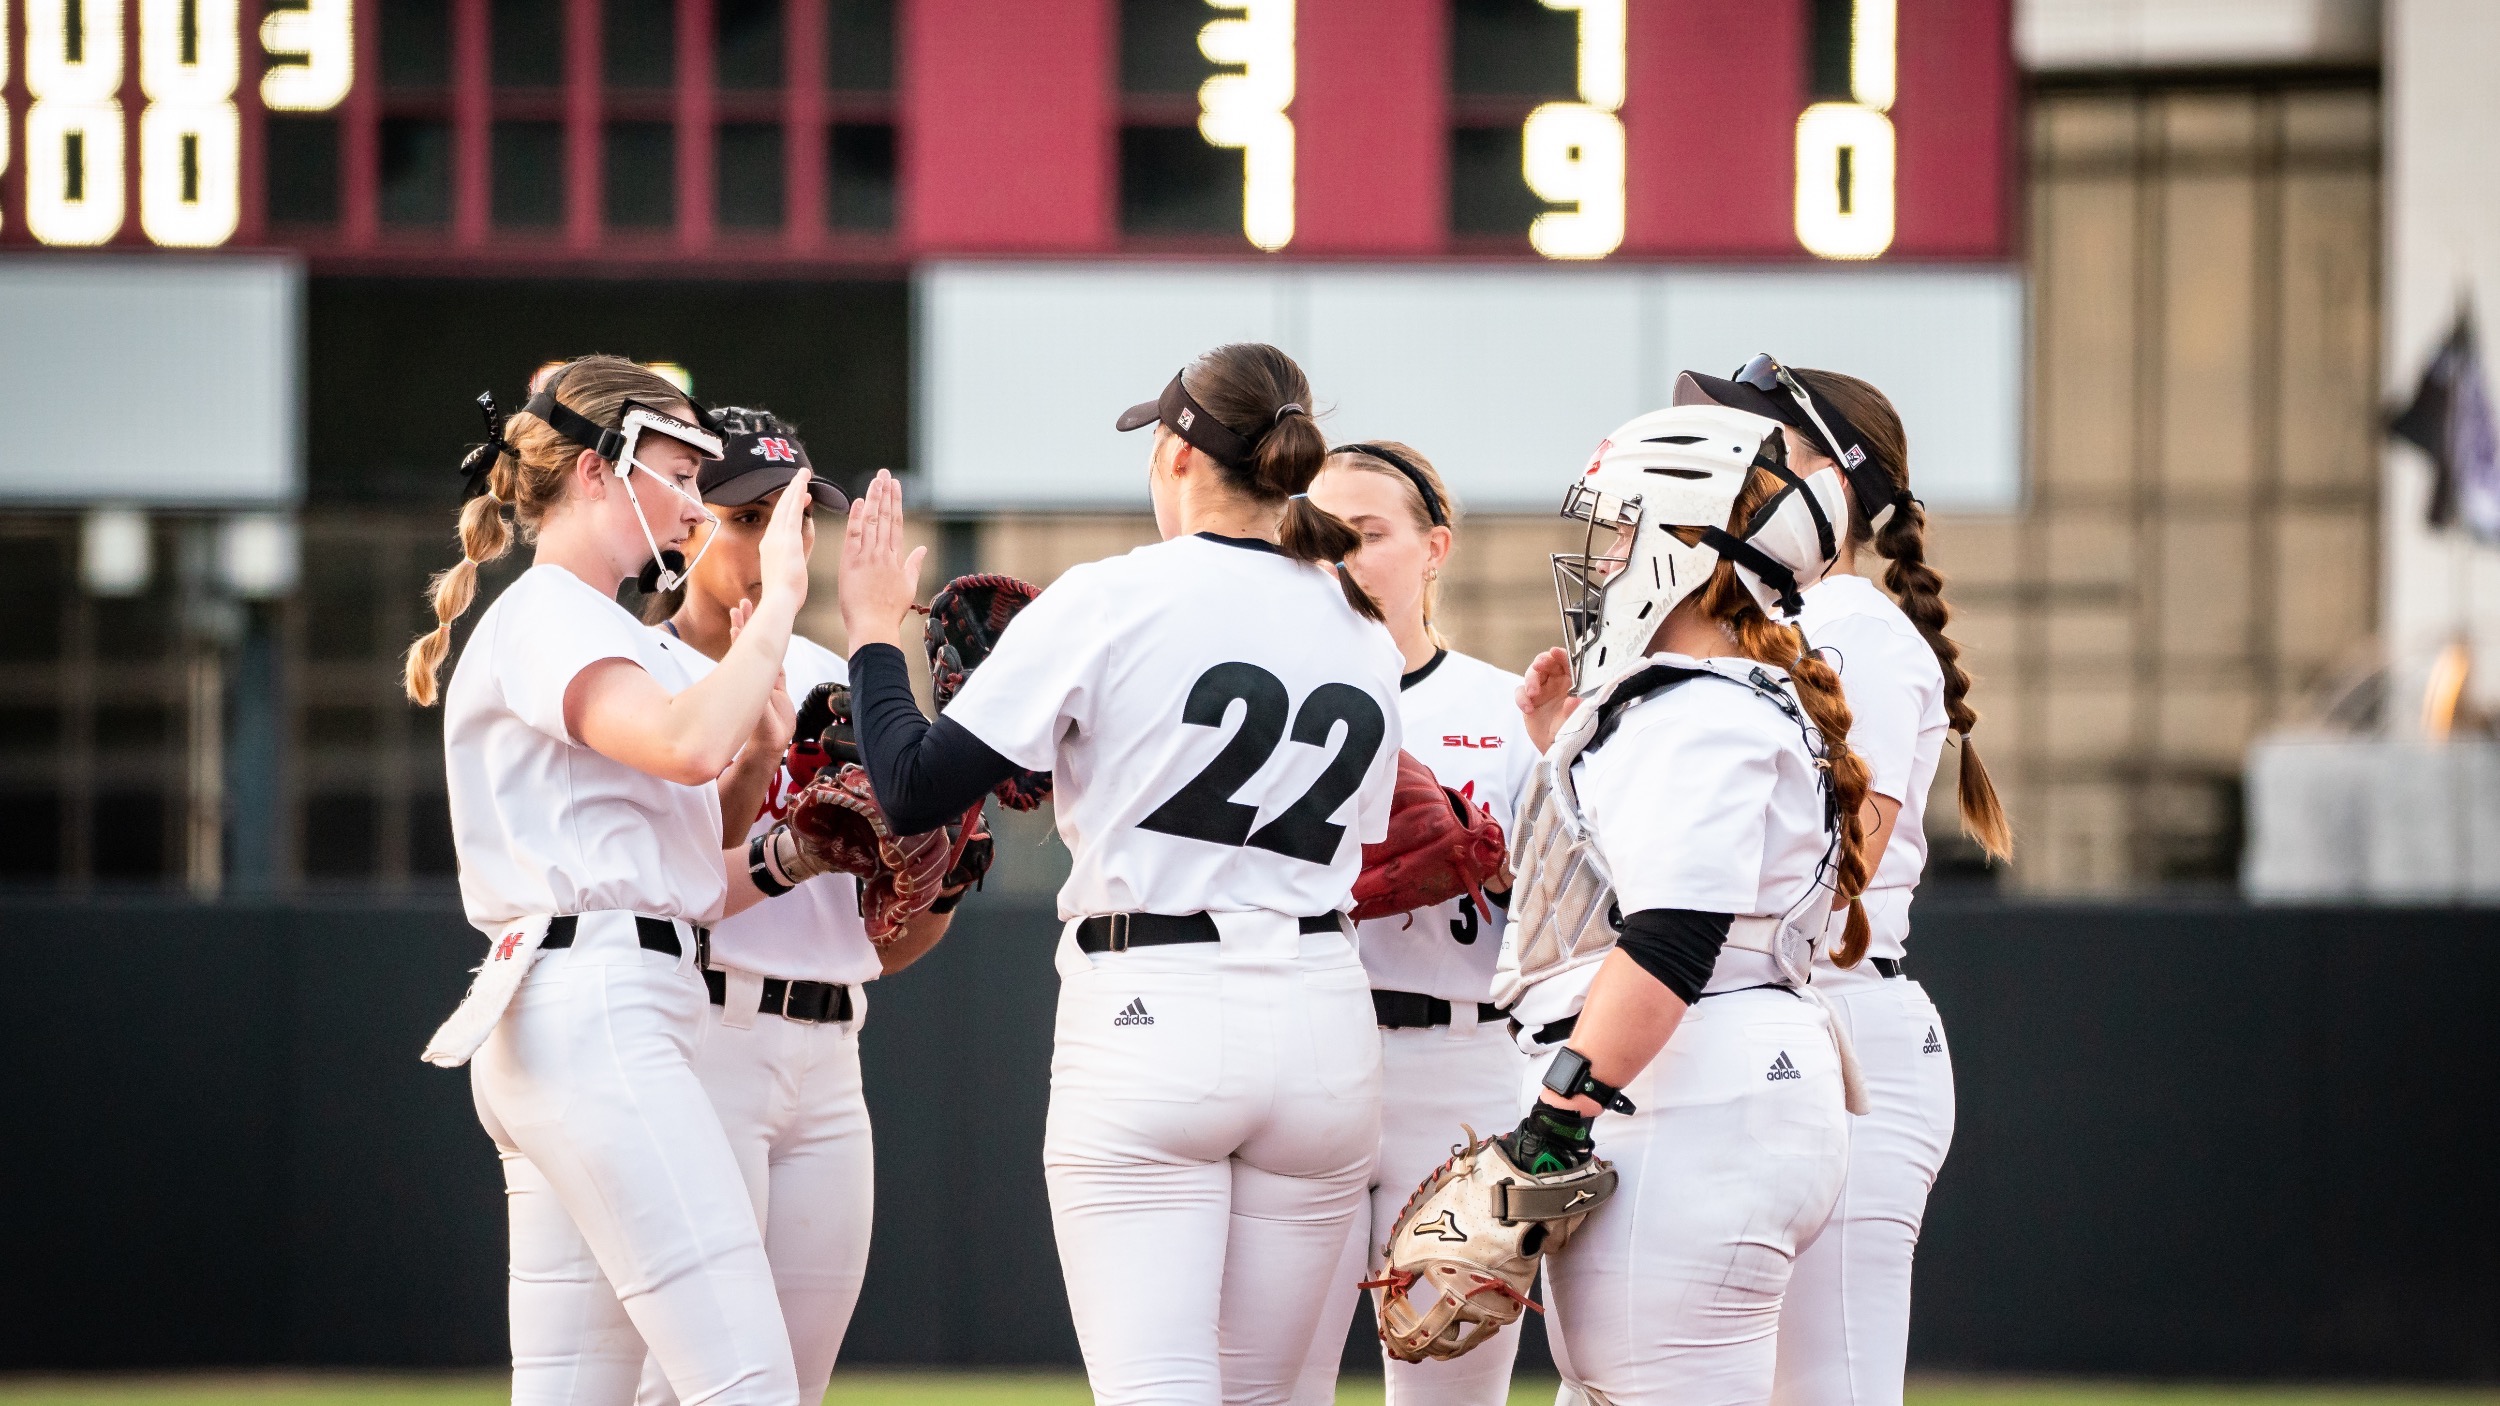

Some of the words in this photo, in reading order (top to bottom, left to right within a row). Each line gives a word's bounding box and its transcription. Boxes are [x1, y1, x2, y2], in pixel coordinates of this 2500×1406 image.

[259, 0, 354, 111] 3
[1198, 0, 1295, 112] 3
[1523, 102, 1626, 259] 9
[1795, 102, 1896, 259] 0
[757, 436, 796, 462] N
[1134, 660, 1386, 866] 22
[1113, 1014, 1155, 1027] adidas
[1766, 1068, 1801, 1081] adidas
